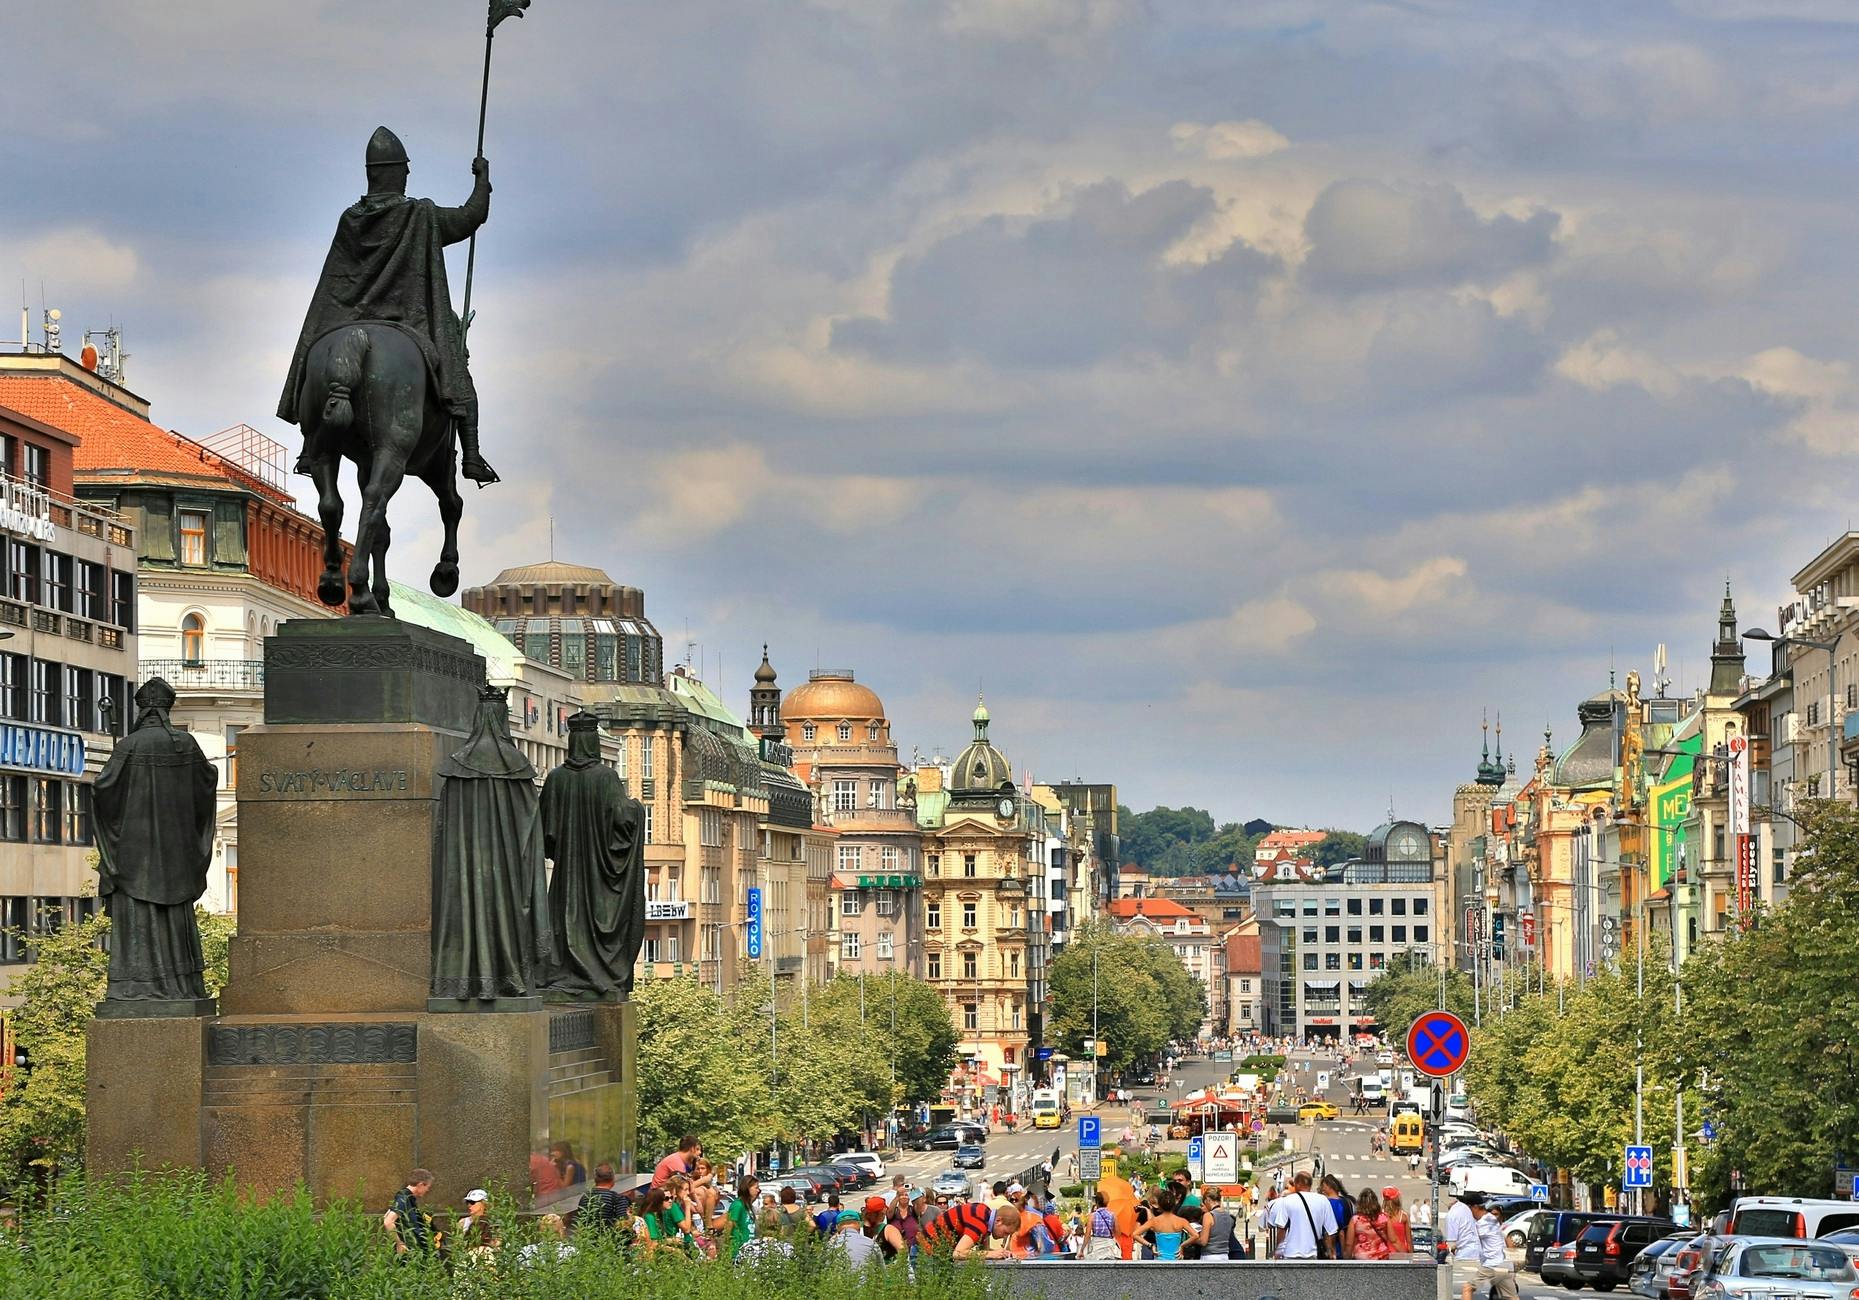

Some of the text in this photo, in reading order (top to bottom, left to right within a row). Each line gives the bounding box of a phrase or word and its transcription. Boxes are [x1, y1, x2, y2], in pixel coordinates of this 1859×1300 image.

[0, 727, 80, 772] JEXPORT
[1733, 760, 1744, 832] RAMADA
[750, 893, 759, 955] ROKOKO
[1083, 1120, 1096, 1138] P
[1190, 1146, 1199, 1157] P
